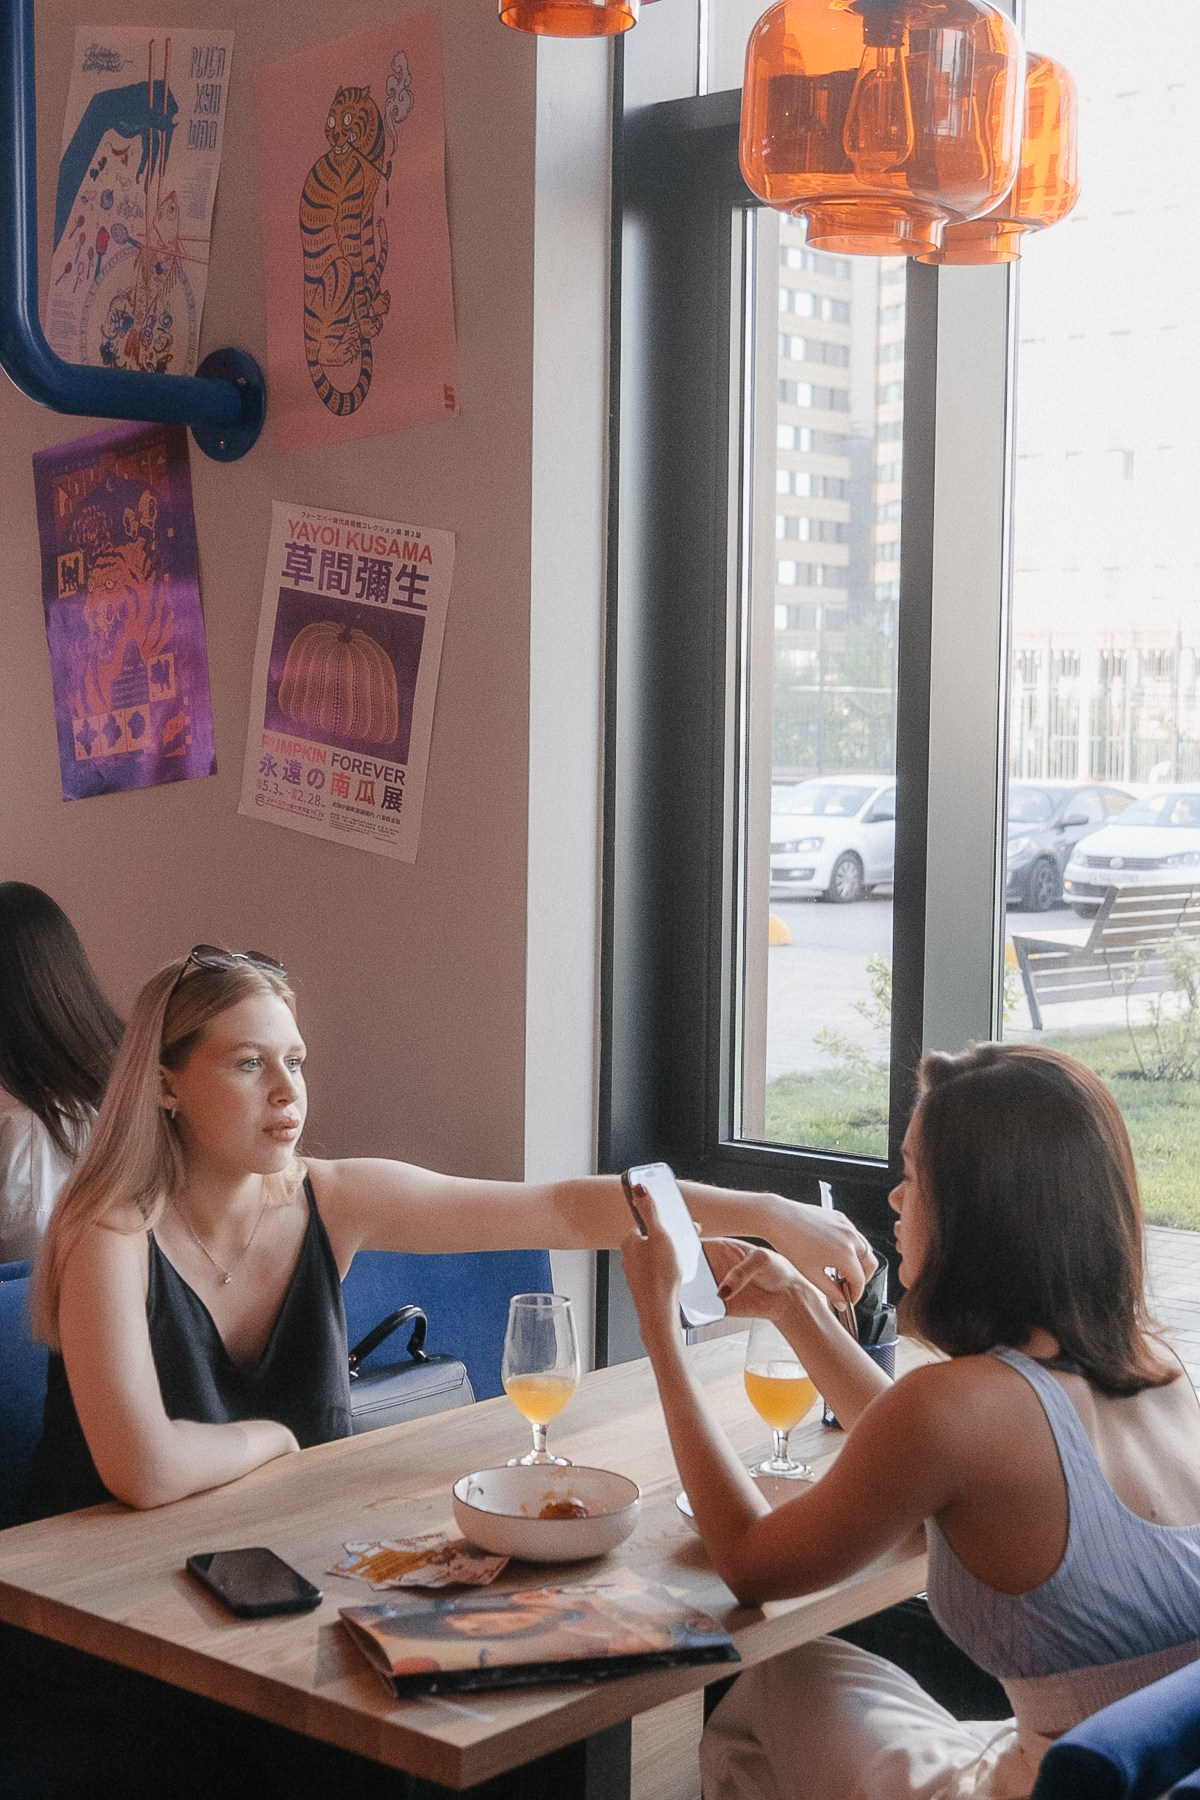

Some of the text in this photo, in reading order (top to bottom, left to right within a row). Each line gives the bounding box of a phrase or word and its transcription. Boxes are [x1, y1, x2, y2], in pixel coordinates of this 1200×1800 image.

[287, 519, 433, 565] YAYOI KUSAMA
[281, 541, 430, 611] 草間彌生
[261, 734, 406, 786] PUMPKIN FOREVER
